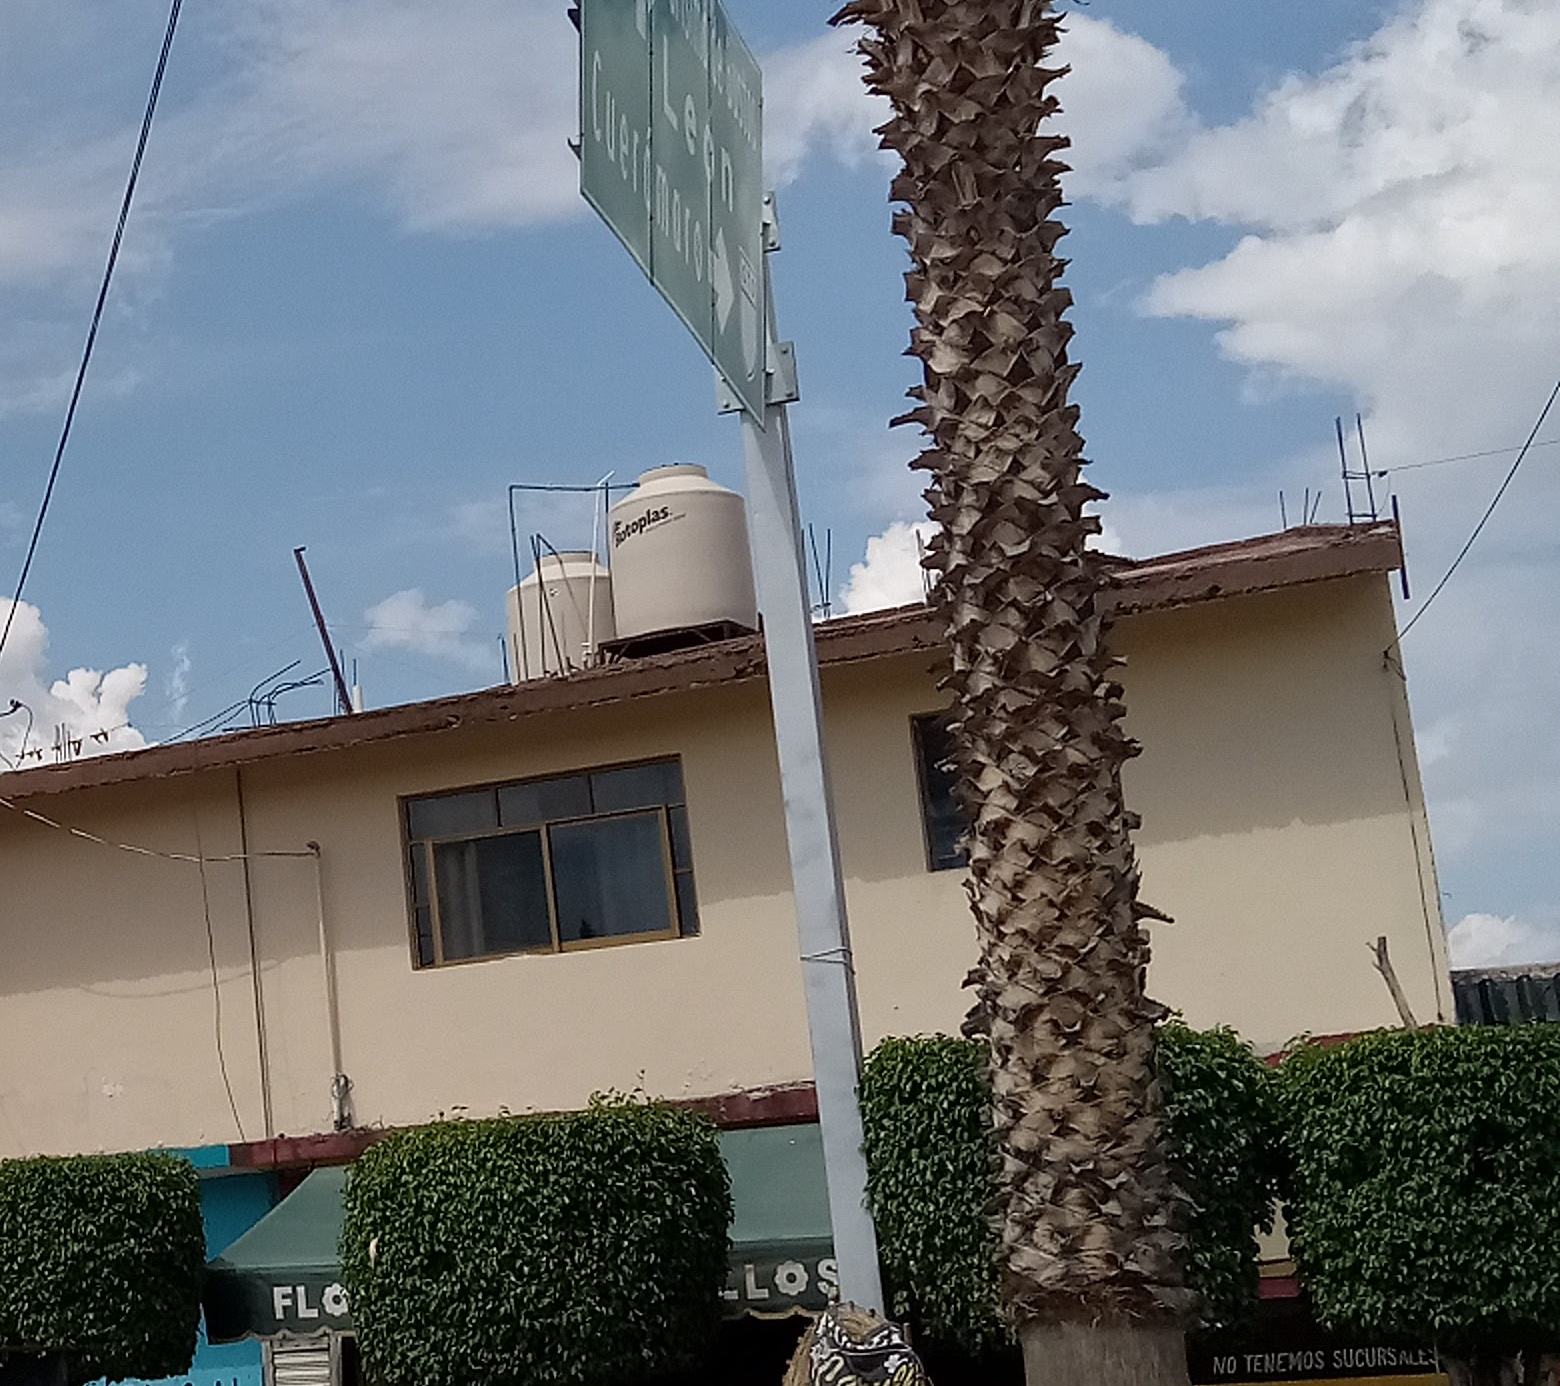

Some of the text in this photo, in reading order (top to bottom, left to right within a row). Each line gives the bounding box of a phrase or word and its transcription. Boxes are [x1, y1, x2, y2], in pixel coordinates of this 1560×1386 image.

[273, 1282, 349, 1321] FLO
[1213, 1356, 1237, 1375] NO
[1243, 1350, 1325, 1373] TENEMOS
